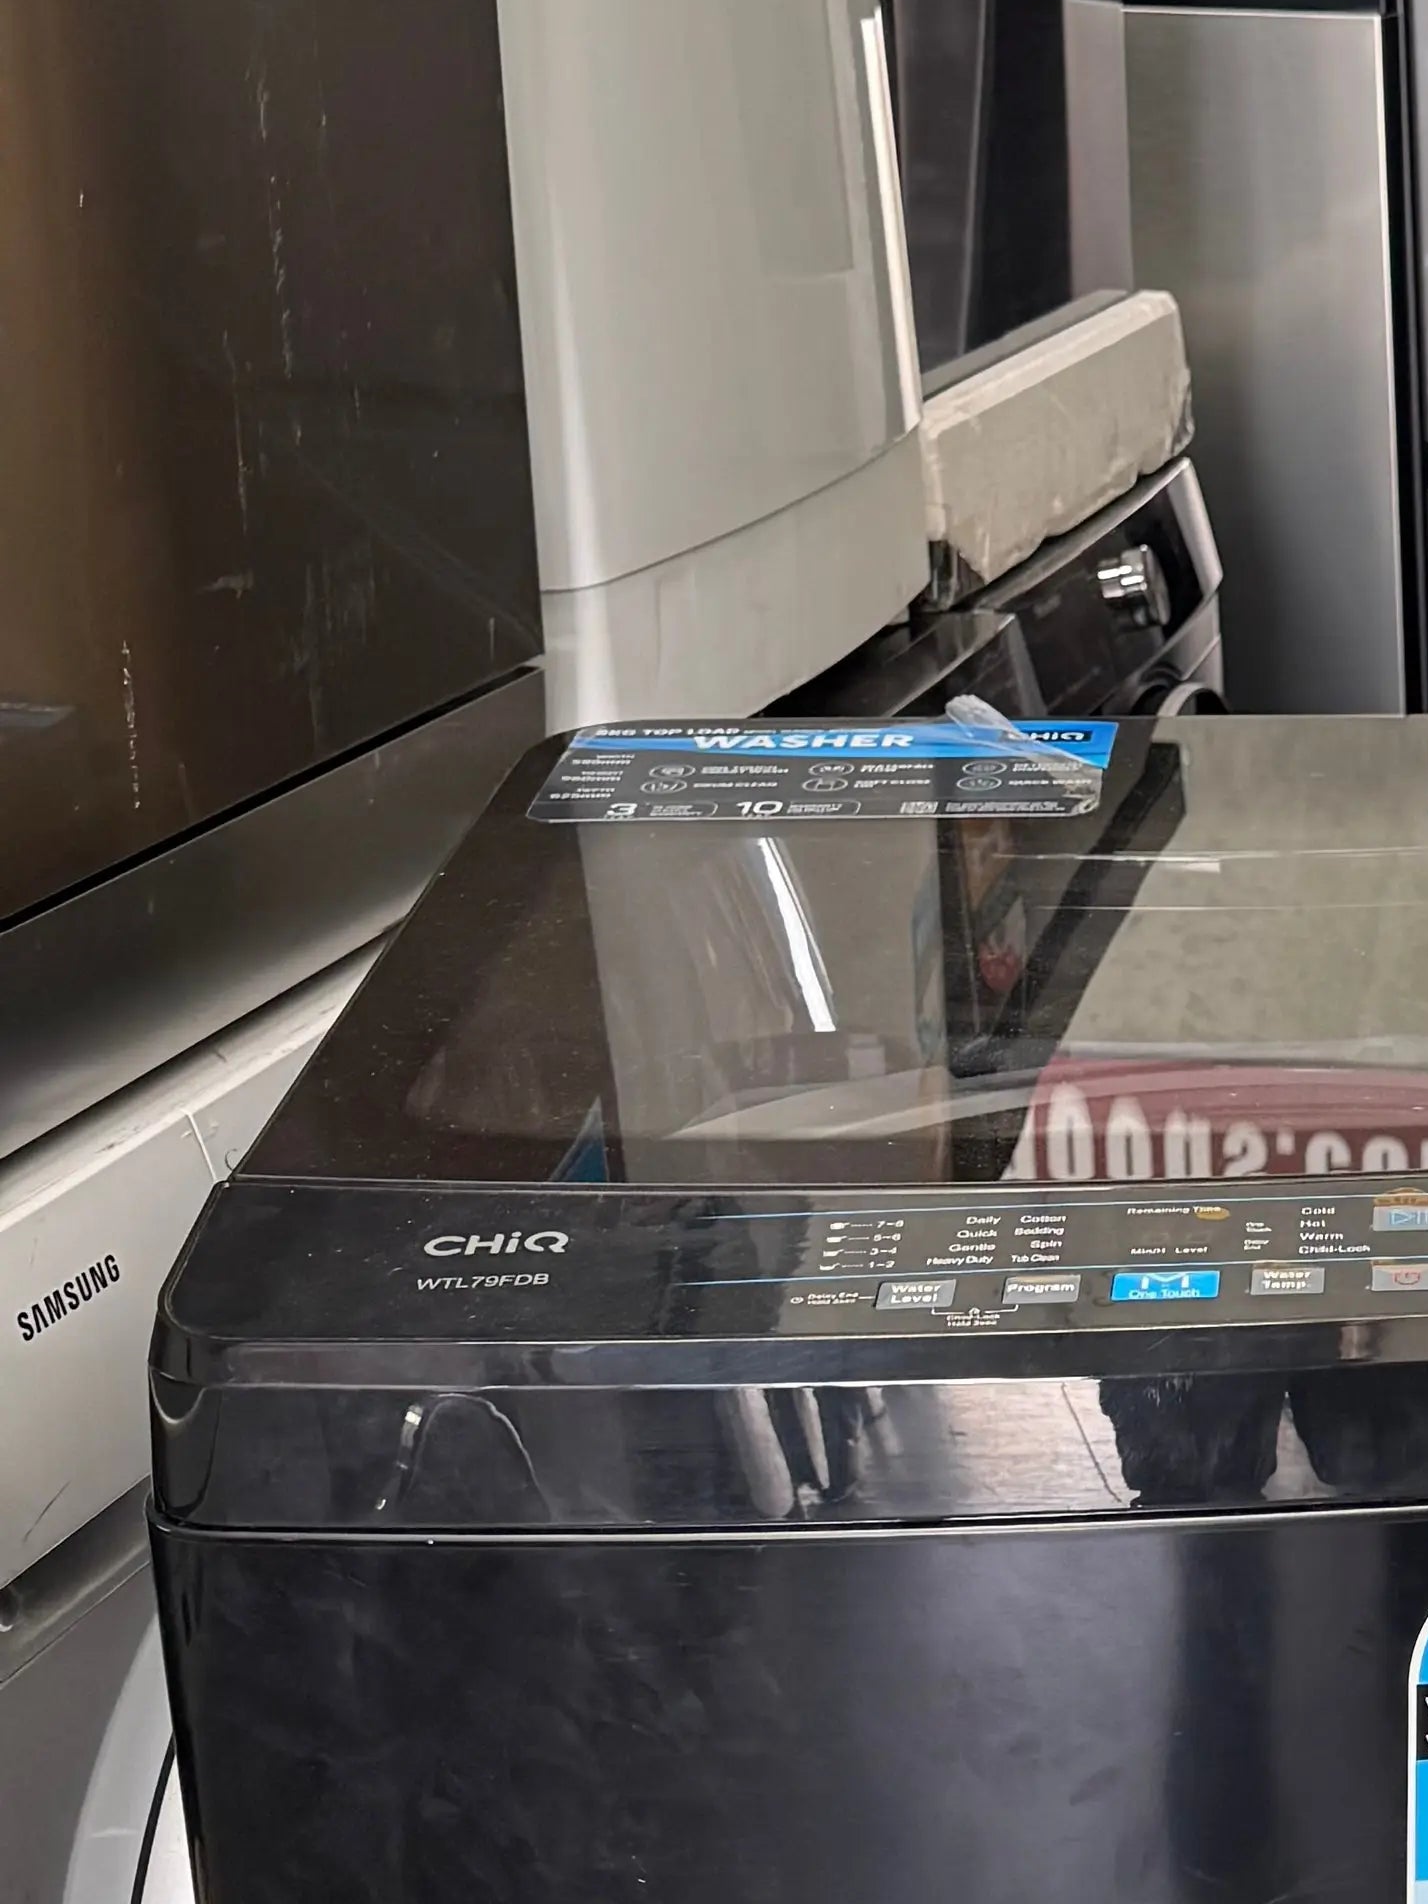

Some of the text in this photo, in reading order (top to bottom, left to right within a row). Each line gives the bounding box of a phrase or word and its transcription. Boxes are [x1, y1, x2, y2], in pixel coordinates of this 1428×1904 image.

[693, 733, 914, 749] WASHER
[1127, 1206, 1190, 1215] Remaining
[1301, 1206, 1336, 1216] Cold
[966, 1214, 1067, 1225] Daily Cotton
[1300, 1219, 1326, 1228] Hot
[956, 1229, 998, 1238] Quick
[1299, 1232, 1344, 1241] Warm
[1175, 1245, 1208, 1254] Level
[1263, 1270, 1311, 1280] Water
[416, 1273, 550, 1291] WTL79FDB
[890, 1284, 941, 1294] Water
[1005, 1282, 1075, 1294] Program
[1128, 1288, 1200, 1298] One Touch
[17, 1253, 121, 1342] SAMSUNG
[890, 1293, 938, 1303] Level
